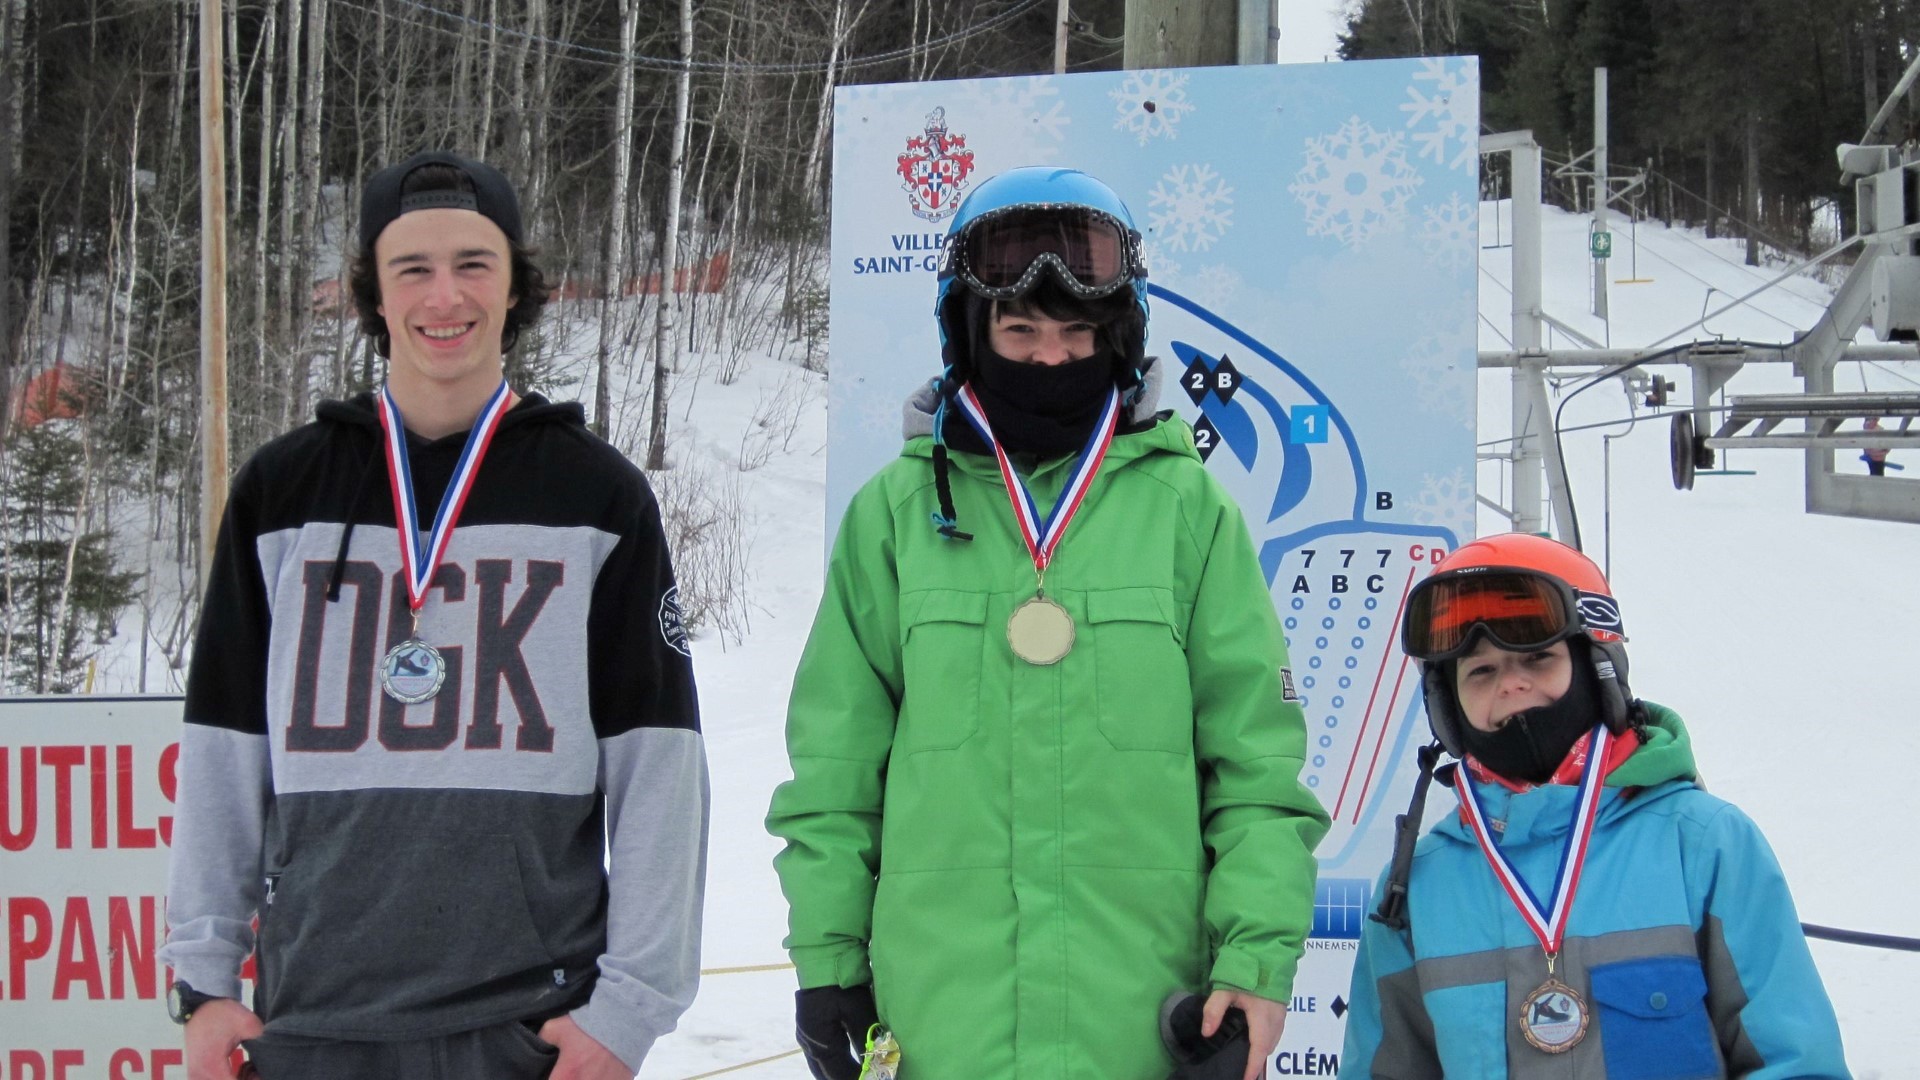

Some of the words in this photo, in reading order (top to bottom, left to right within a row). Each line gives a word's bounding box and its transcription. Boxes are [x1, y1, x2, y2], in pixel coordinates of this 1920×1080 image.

[891, 233, 944, 251] VILLE
[853, 254, 941, 274] SAINT-G
[1191, 373, 1204, 389] 2
[1218, 372, 1232, 388] B
[1303, 415, 1315, 434] 1
[1196, 429, 1211, 448] 2
[1376, 491, 1394, 511] B
[1301, 550, 1316, 569] 7
[1340, 550, 1355, 569] 7
[1377, 550, 1392, 569] 7
[1409, 544, 1425, 562] C
[1431, 548, 1446, 565] D
[1292, 575, 1311, 594] A
[1331, 574, 1349, 594] B
[1366, 574, 1385, 594] C
[285, 558, 565, 753] DGK
[0, 895, 174, 1001] PAN
[1303, 940, 1359, 950] NNEMEN
[1275, 1047, 1339, 1076] CLÉM
